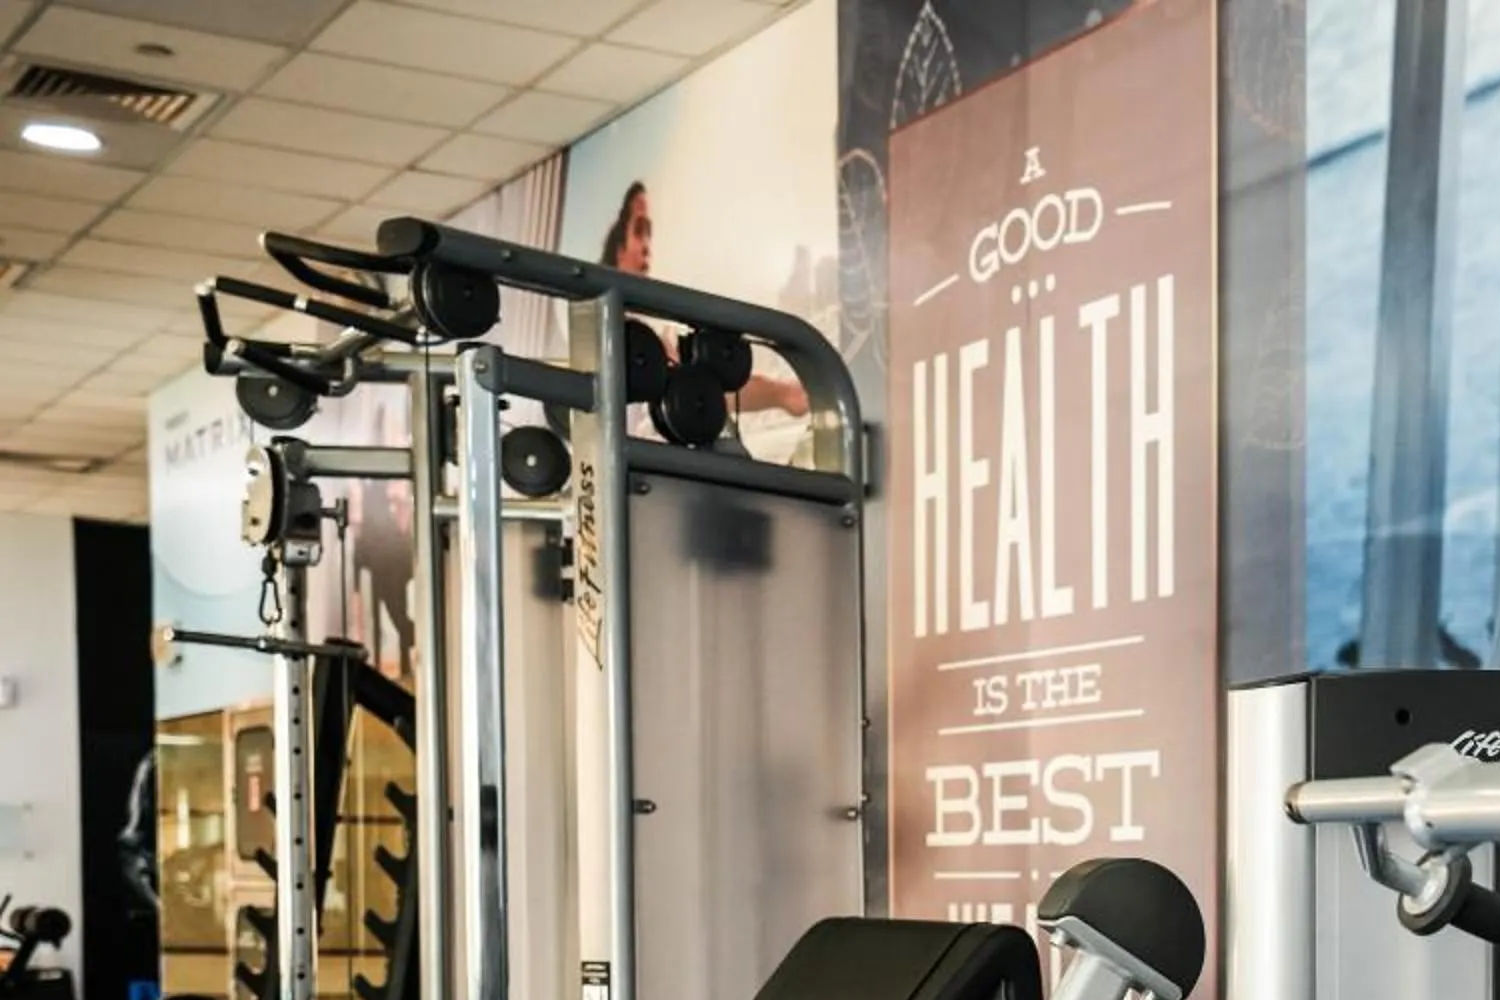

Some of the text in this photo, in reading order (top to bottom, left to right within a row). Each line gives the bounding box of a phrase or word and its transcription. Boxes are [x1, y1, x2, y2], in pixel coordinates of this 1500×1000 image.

[1019, 145, 1046, 184] A
[968, 187, 1103, 283] GOOD
[913, 273, 1174, 638] HEALTH
[577, 461, 603, 672] Life Fitness
[972, 663, 1102, 716] IS THE
[925, 749, 1160, 848] BEST
